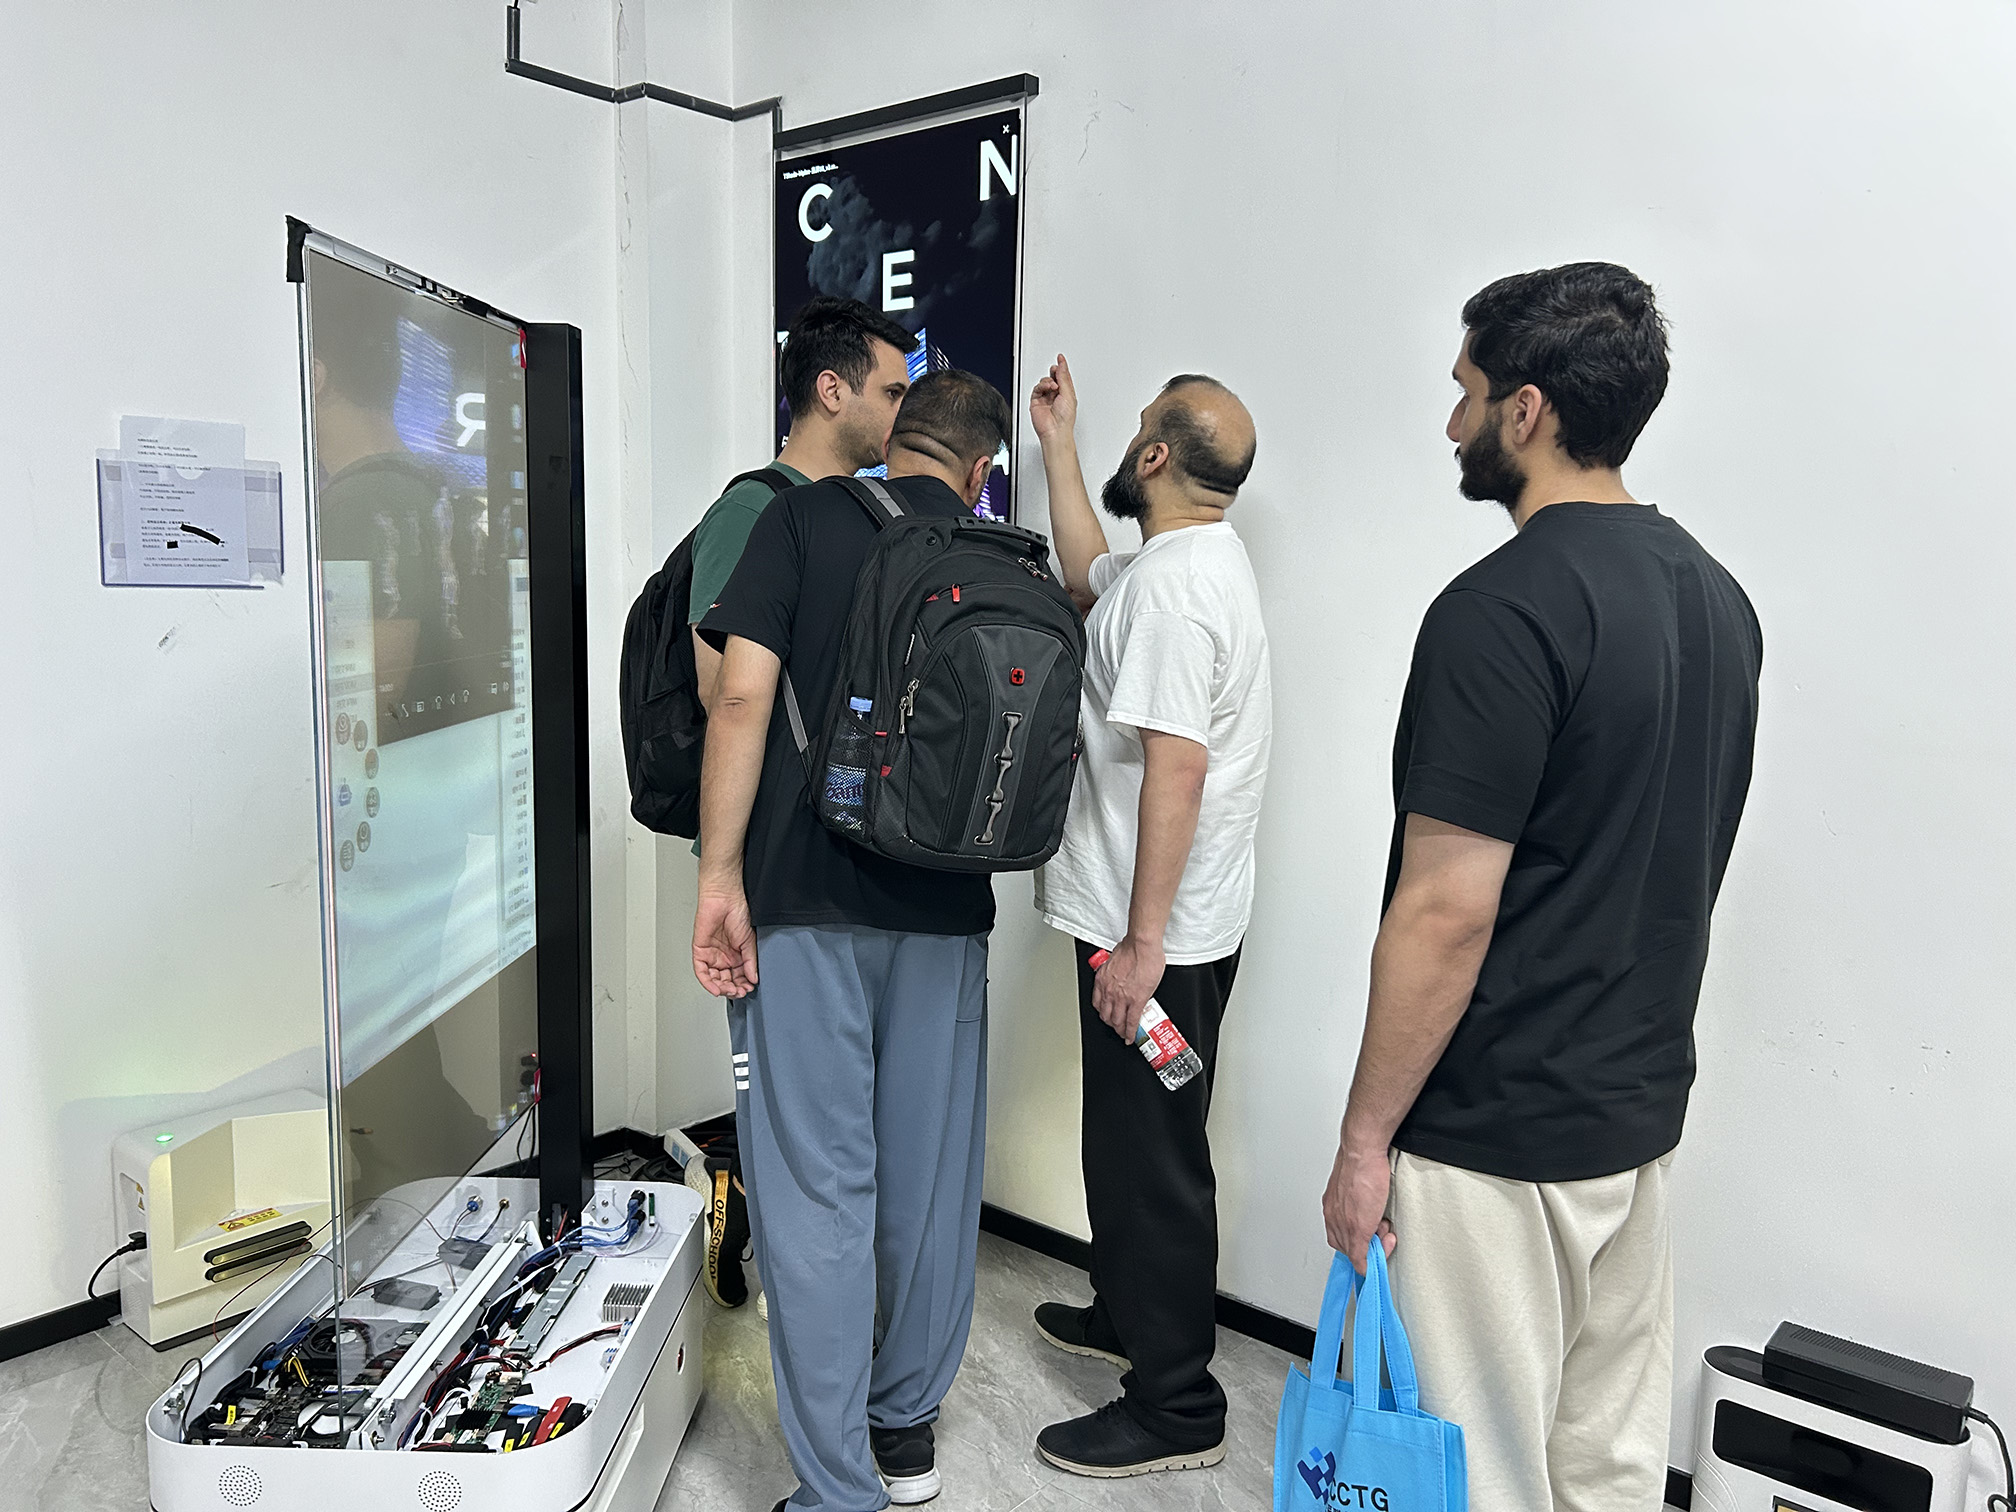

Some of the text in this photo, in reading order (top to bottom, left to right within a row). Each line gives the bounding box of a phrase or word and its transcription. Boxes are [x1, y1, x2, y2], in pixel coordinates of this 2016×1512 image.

[980, 134, 1017, 202] N
[798, 183, 834, 243] C
[882, 249, 915, 312] E
